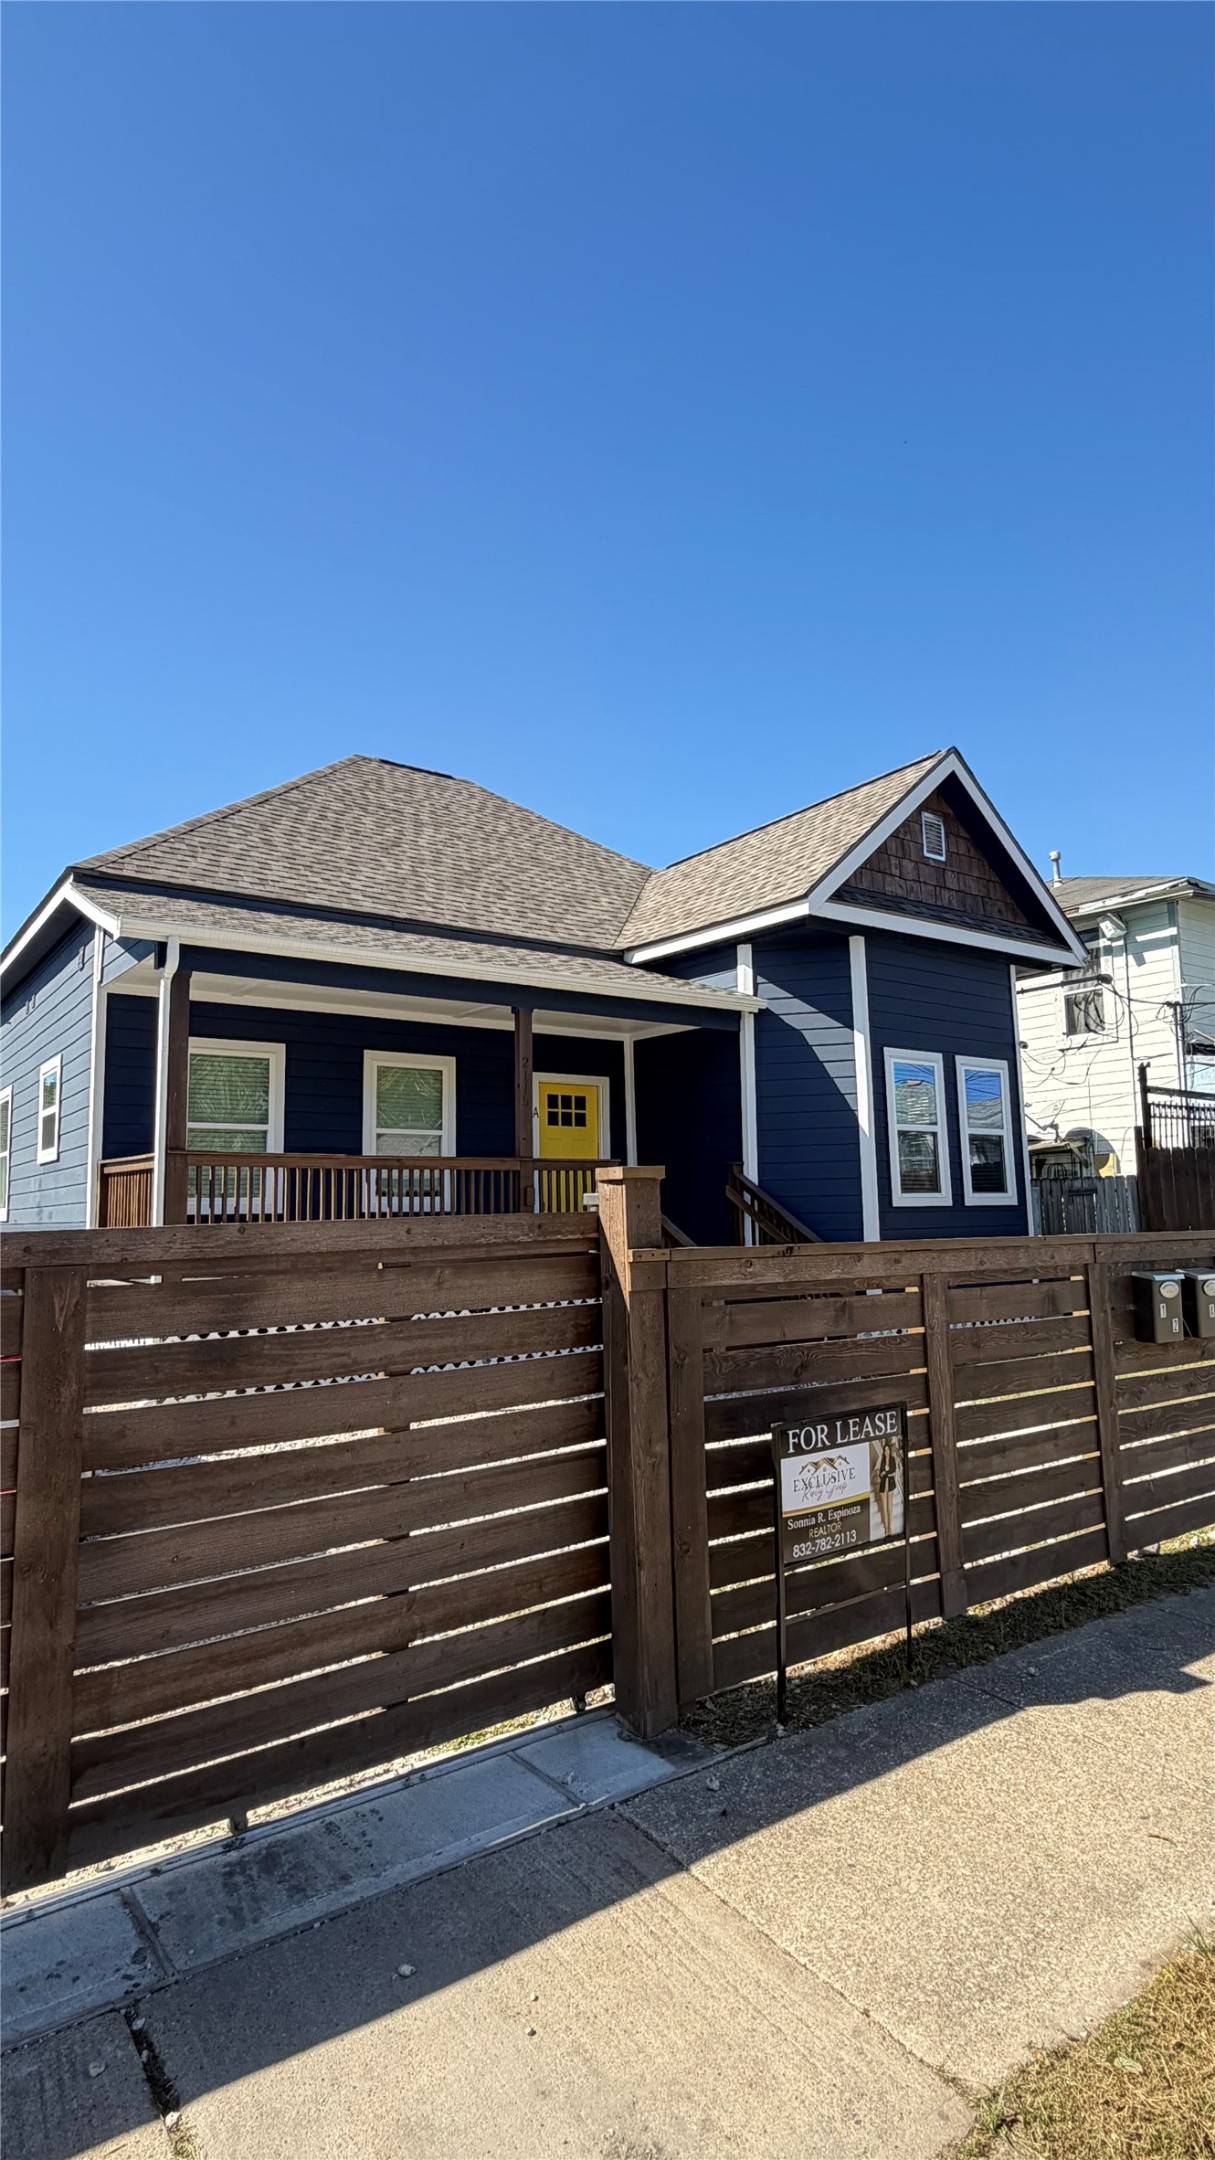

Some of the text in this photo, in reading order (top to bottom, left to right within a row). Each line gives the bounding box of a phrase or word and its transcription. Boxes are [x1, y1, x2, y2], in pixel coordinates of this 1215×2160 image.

[532, 1106, 540, 1119] A
[787, 1411, 898, 1454] FOR LEASE
[793, 1467, 856, 1493] EXCLUSIVE
[787, 1504, 861, 1530] Sonnia R. Espinoza
[808, 1521, 843, 1539] REALTOR
[792, 1529, 857, 1558] 832-782-2113
